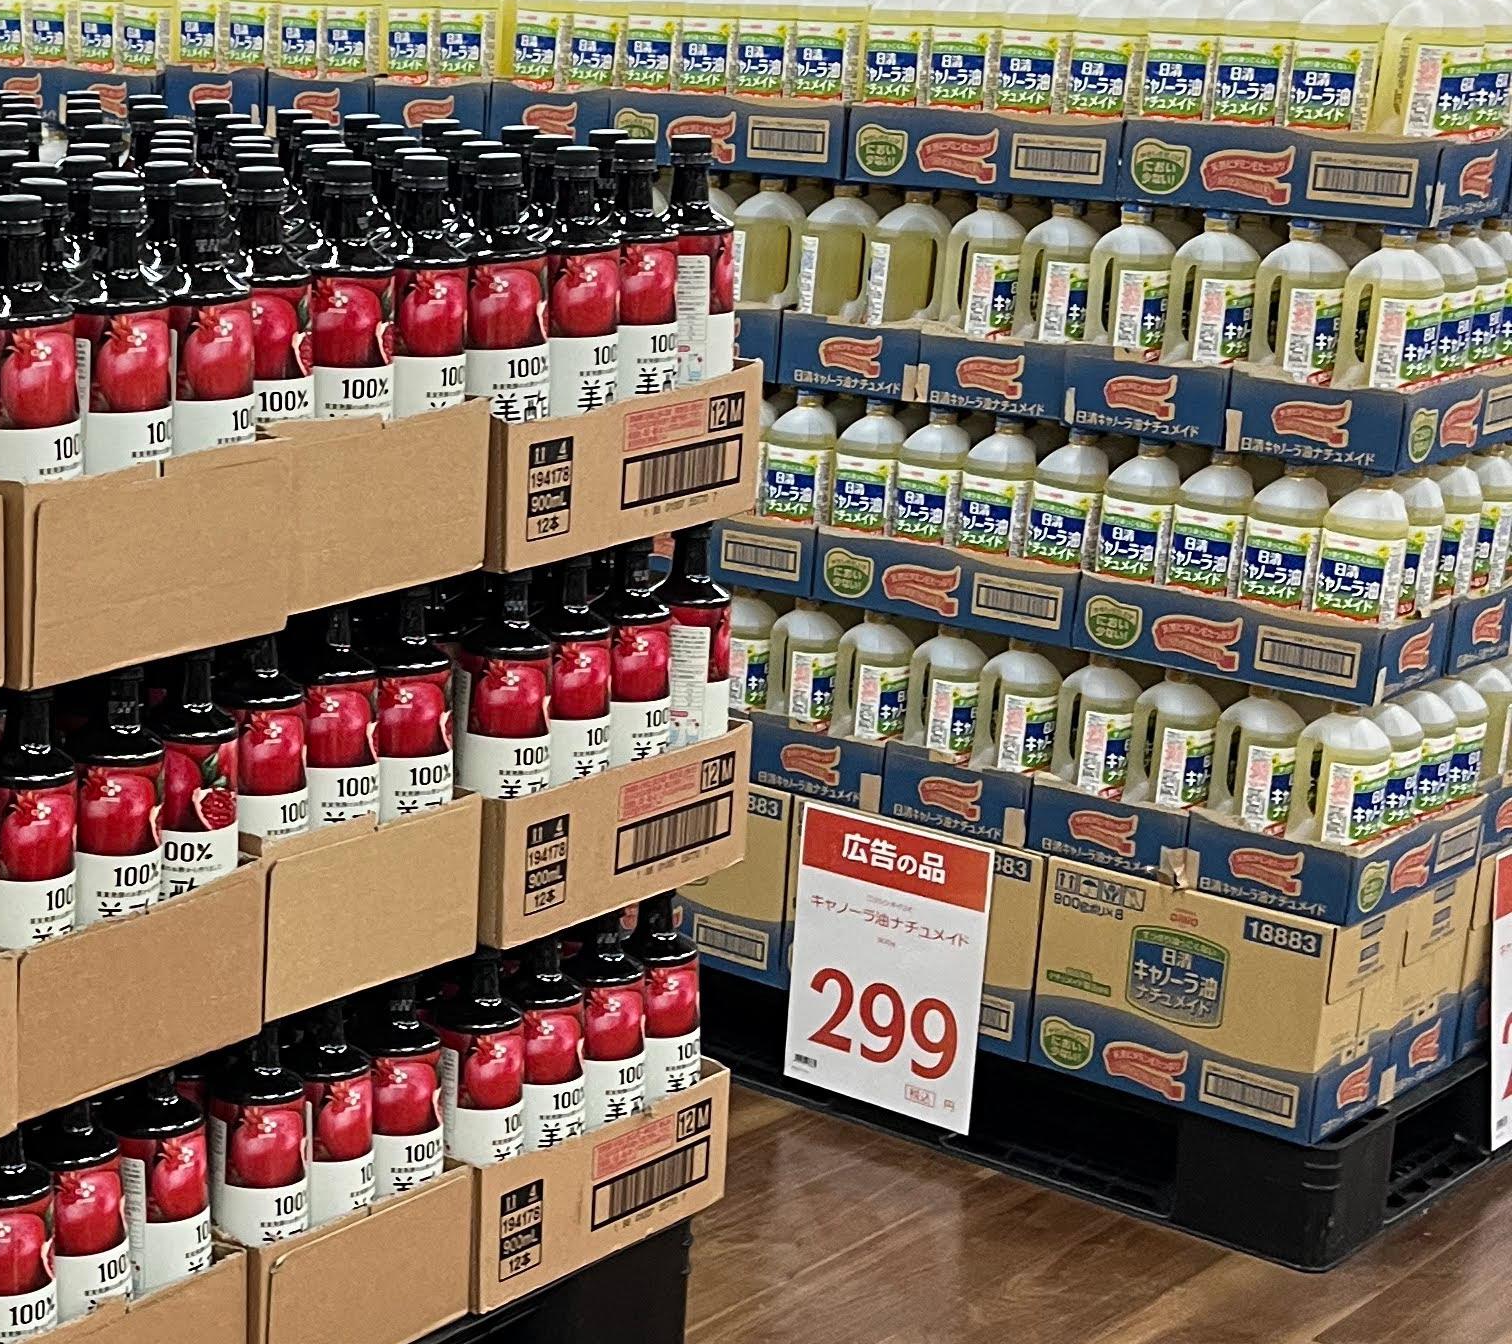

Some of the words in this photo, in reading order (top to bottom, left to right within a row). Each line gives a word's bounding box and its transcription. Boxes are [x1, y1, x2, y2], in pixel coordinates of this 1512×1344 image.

[1142, 161, 1177, 173] におい
[507, 355, 549, 379] 100%
[341, 377, 389, 399] 100%
[258, 390, 309, 412] 100%
[1240, 436, 1375, 466] 日清キャノーラ油ナチュメイド
[530, 466, 570, 490] 194178
[532, 492, 567, 513] 900mL
[537, 516, 560, 534] 12本
[832, 566, 861, 582] におい
[1096, 614, 1131, 630] におい
[164, 842, 214, 863] 00%
[528, 841, 566, 868] 194178
[842, 832, 946, 884] 広告の品
[528, 865, 563, 889] 900mL
[810, 894, 969, 948] キャノーラ油ナチュメイド
[1248, 920, 1317, 954] 18883
[1162, 948, 1192, 970] 日清
[1134, 959, 1218, 1000] キャノーラ油
[1136, 985, 1209, 1018] ナチュメイド
[807, 967, 958, 1080] 299
[502, 1206, 542, 1234] 194178
